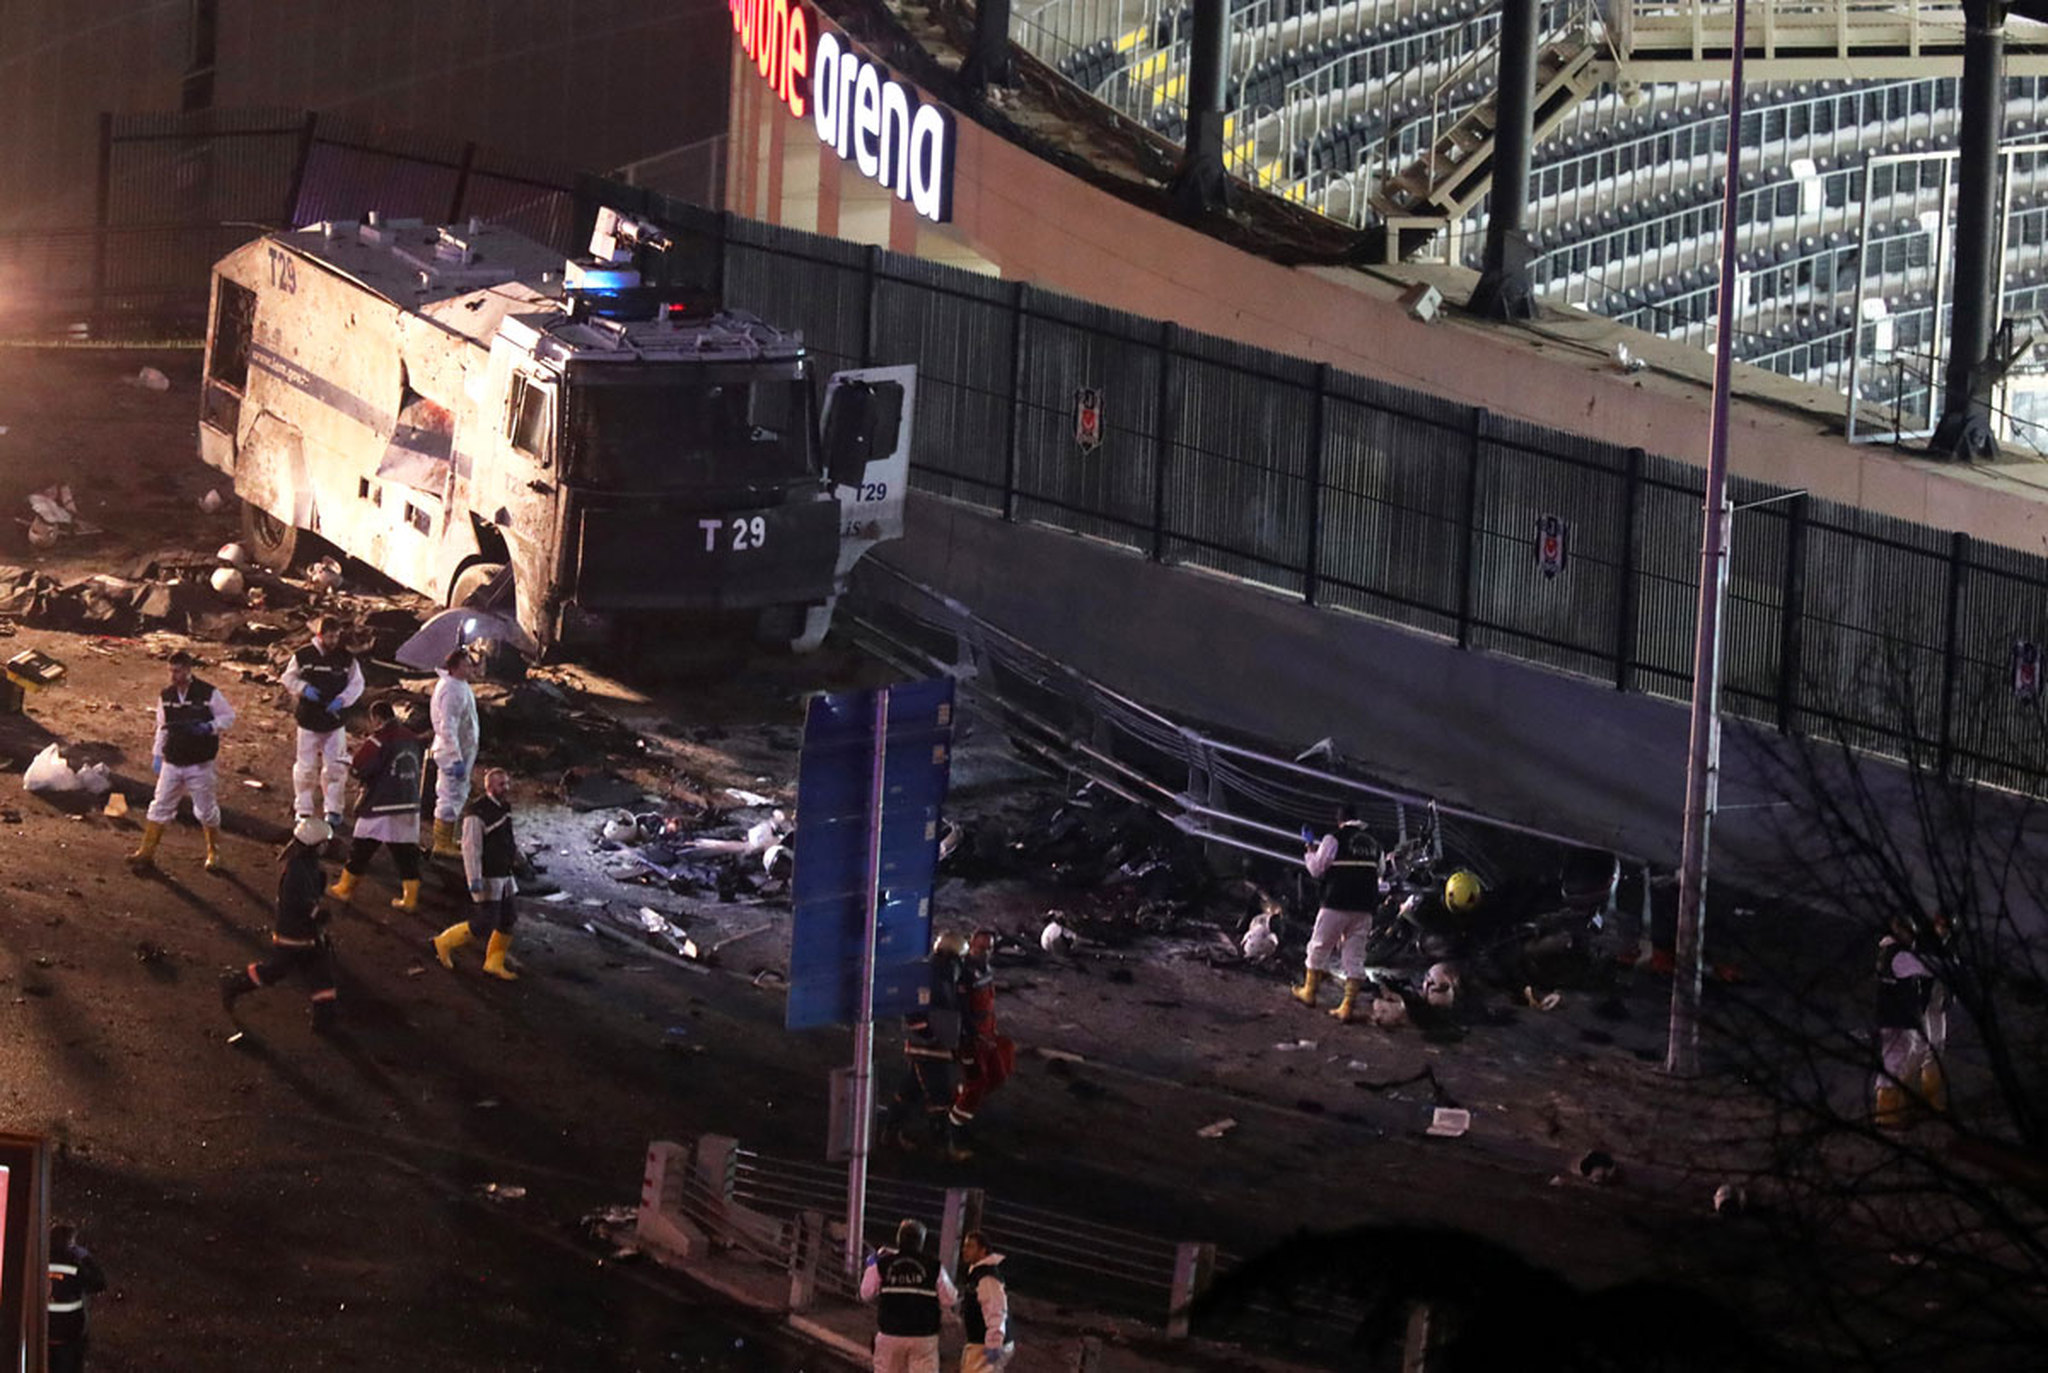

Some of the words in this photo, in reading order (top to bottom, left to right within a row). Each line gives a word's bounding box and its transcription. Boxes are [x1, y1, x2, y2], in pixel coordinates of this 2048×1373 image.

[814, 32, 945, 222] arena
[268, 246, 297, 295] T29
[856, 482, 887, 502] T29
[699, 519, 722, 551] T
[733, 516, 766, 550] 29
